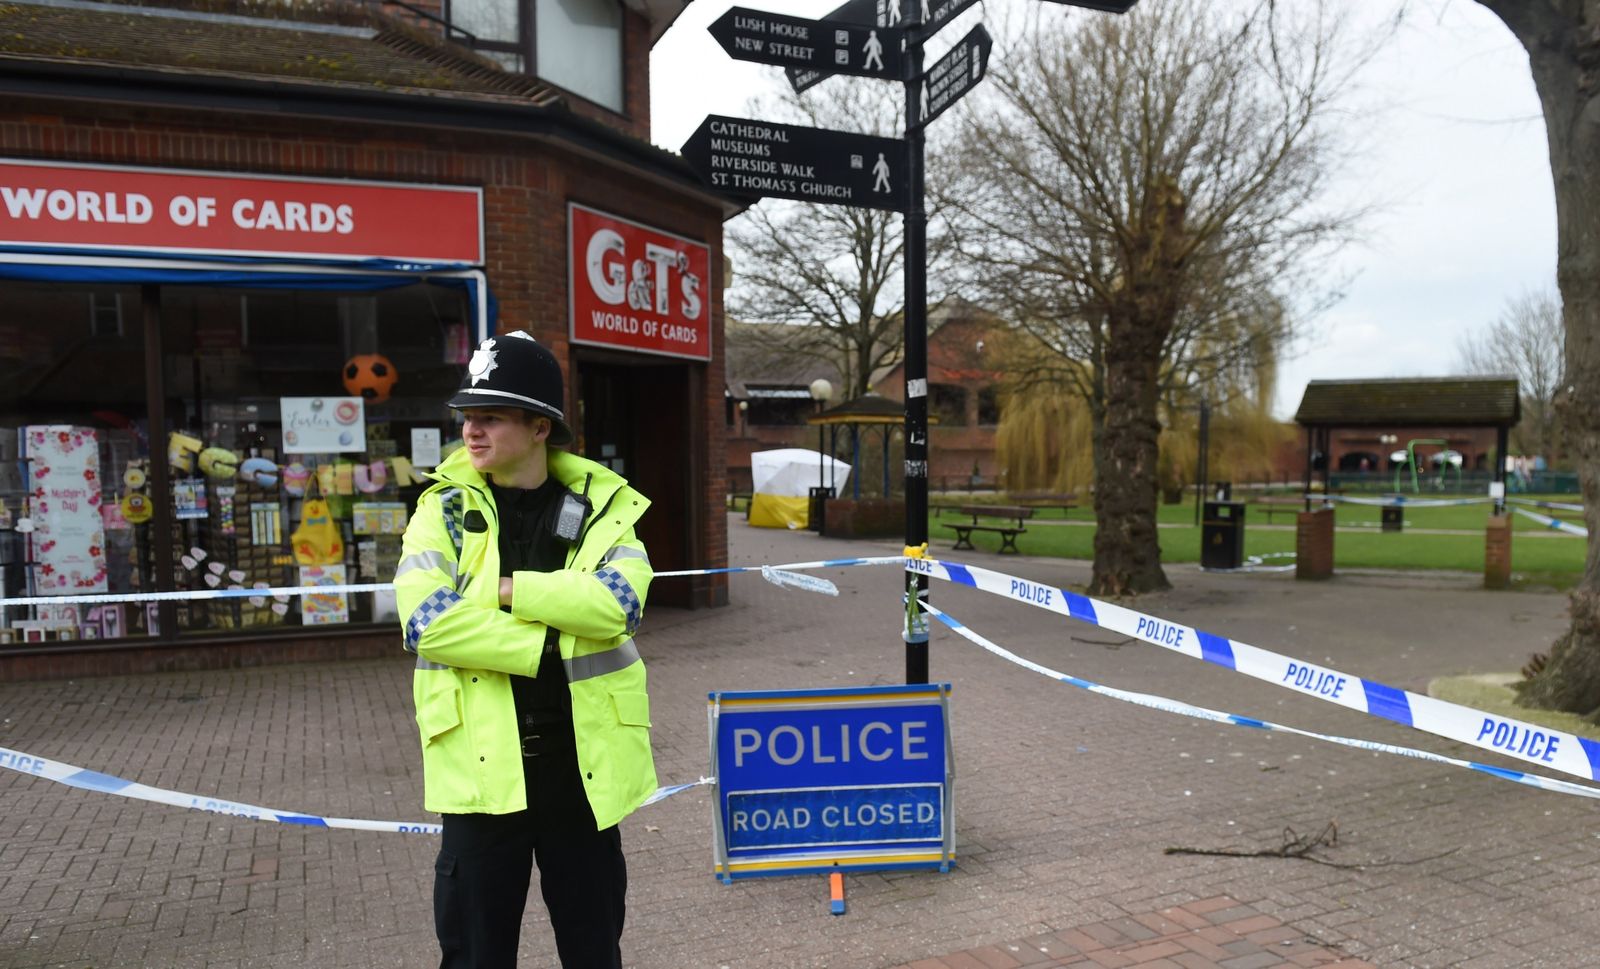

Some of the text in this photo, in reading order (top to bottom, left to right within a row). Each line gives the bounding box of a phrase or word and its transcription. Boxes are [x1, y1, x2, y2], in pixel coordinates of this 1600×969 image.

[734, 15, 809, 41] LUSH HOUSE
[735, 37, 815, 61] NEW STREET
[710, 121, 790, 144] CATHEDRAL
[710, 138, 771, 157] MUSEUMS
[711, 154, 815, 179] RIVERSIDE WALK
[733, 174, 797, 194] THOMAS'S
[800, 182, 852, 199] CHURCH
[0, 186, 355, 235] WORLD OF CARDS
[592, 310, 698, 344] WORLD OF CARDS
[61, 499, 79, 513] Day
[1011, 579, 1052, 606] POLICE
[1136, 616, 1185, 648] POLICE
[1282, 661, 1347, 700] POLICE
[733, 720, 930, 768] POLICE
[1476, 717, 1561, 763] POLICE
[732, 802, 935, 833] ROAD CLOSED
